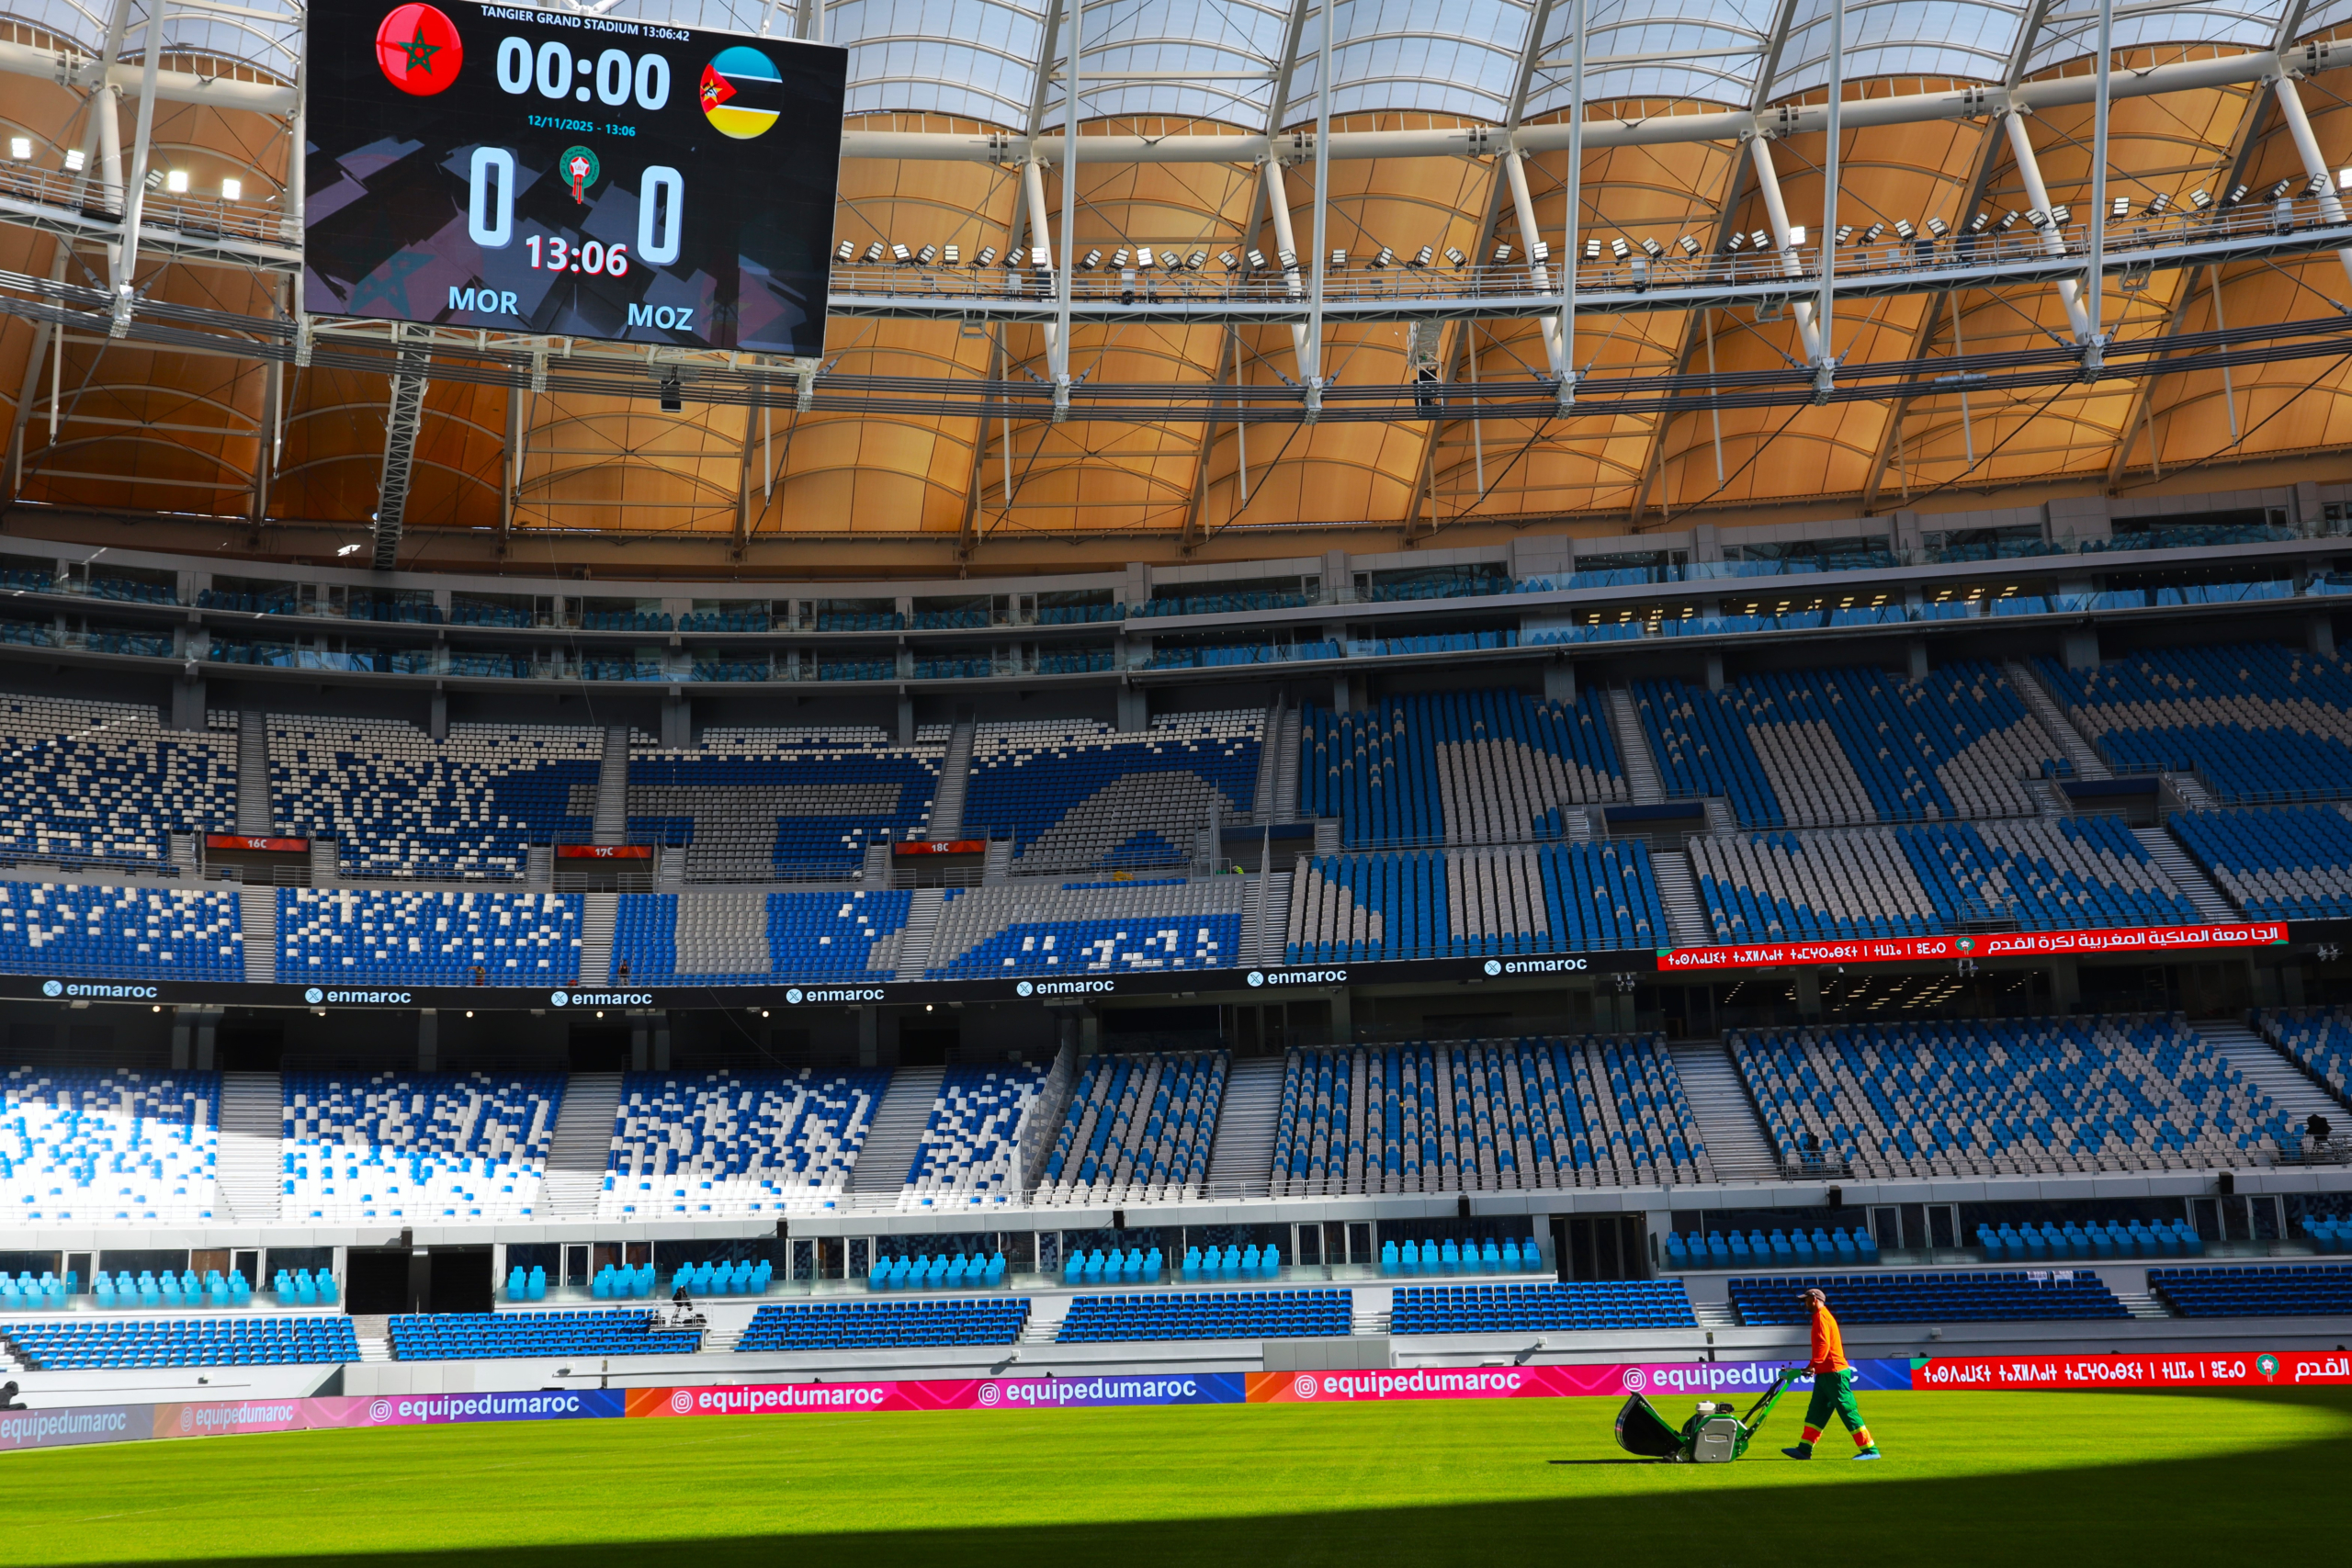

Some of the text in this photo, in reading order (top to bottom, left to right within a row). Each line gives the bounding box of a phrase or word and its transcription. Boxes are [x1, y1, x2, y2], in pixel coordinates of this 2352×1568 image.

[481, 5, 690, 41] TANGIER GRAND STADIUM 13:06:42
[496, 36, 671, 110] 00:00
[527, 115, 594, 132] 12/11/2025
[605, 123, 636, 137] 13:06
[468, 146, 514, 248] 0
[637, 165, 684, 265] 0
[526, 234, 628, 276] 13:06
[448, 285, 519, 316] MOR
[628, 302, 694, 332] MOZ
[247, 837, 267, 849] 16C
[594, 846, 614, 857] 17C
[931, 840, 949, 852] 18C
[1988, 937, 2035, 954] القدم
[2039, 933, 2075, 950] لكرة
[2079, 931, 2146, 950] المغربية
[2149, 930, 2210, 945] الملكية
[1267, 968, 1348, 985] enmaroc
[1505, 957, 1588, 974] enmaroc
[66, 983, 158, 999] enmaroc
[327, 990, 412, 1004] enmaroc
[806, 988, 885, 1002] enmaroc
[1036, 980, 1114, 995] enmaroc
[571, 993, 652, 1005] enmaroc
[2295, 1358, 2350, 1382] القدم
[1005, 1377, 1197, 1405] equipedumaroc
[1323, 1368, 1521, 1398] equipedumaroc
[398, 1393, 580, 1421] equipedumaroc
[698, 1383, 884, 1412] equipedumaroc
[196, 1403, 293, 1427] equipedumaroc
[0, 1411, 127, 1443] equipedumaroc
